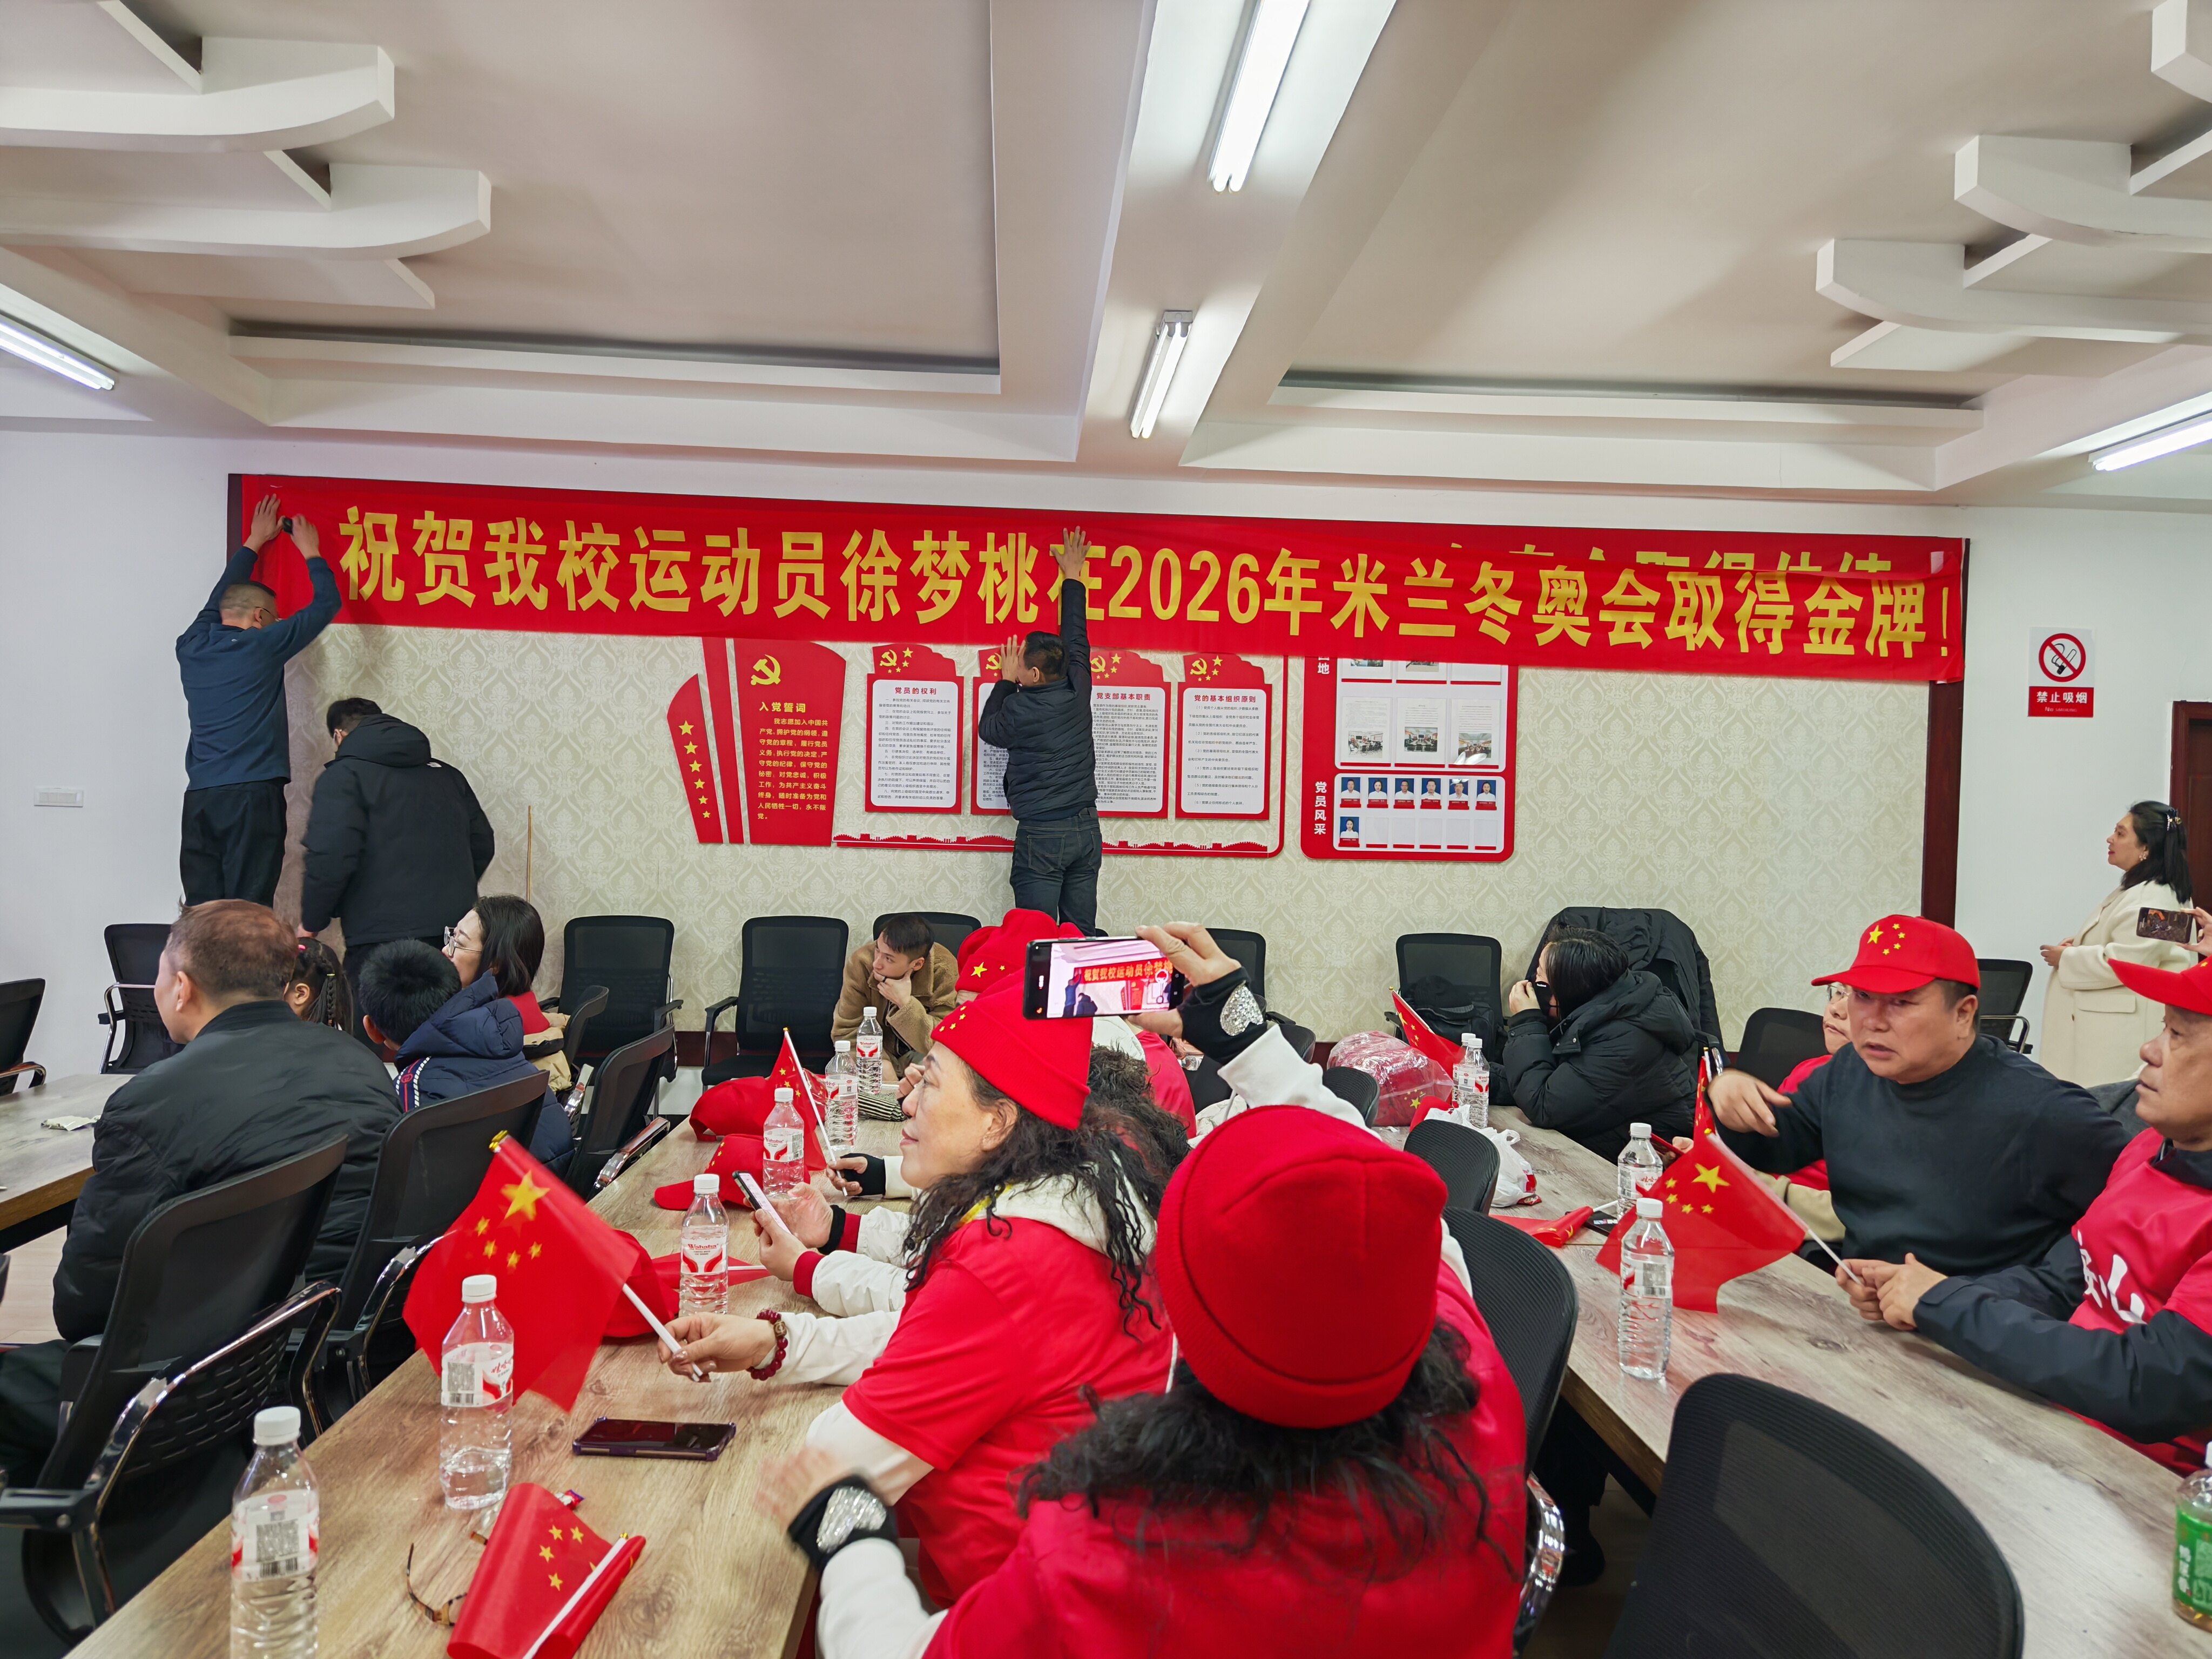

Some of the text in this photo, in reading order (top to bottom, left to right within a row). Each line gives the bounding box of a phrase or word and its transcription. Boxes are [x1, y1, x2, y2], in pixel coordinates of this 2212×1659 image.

[895, 687, 936, 695] 党员的权利
[1096, 692, 1151, 701] 党支部基本职责
[1194, 694, 1256, 703] 党的基本组织原则
[2036, 691, 2087, 704] 禁止吸烟
[759, 702, 806, 713] 入党誓词
[1314, 781, 1327, 835] 党员风采
